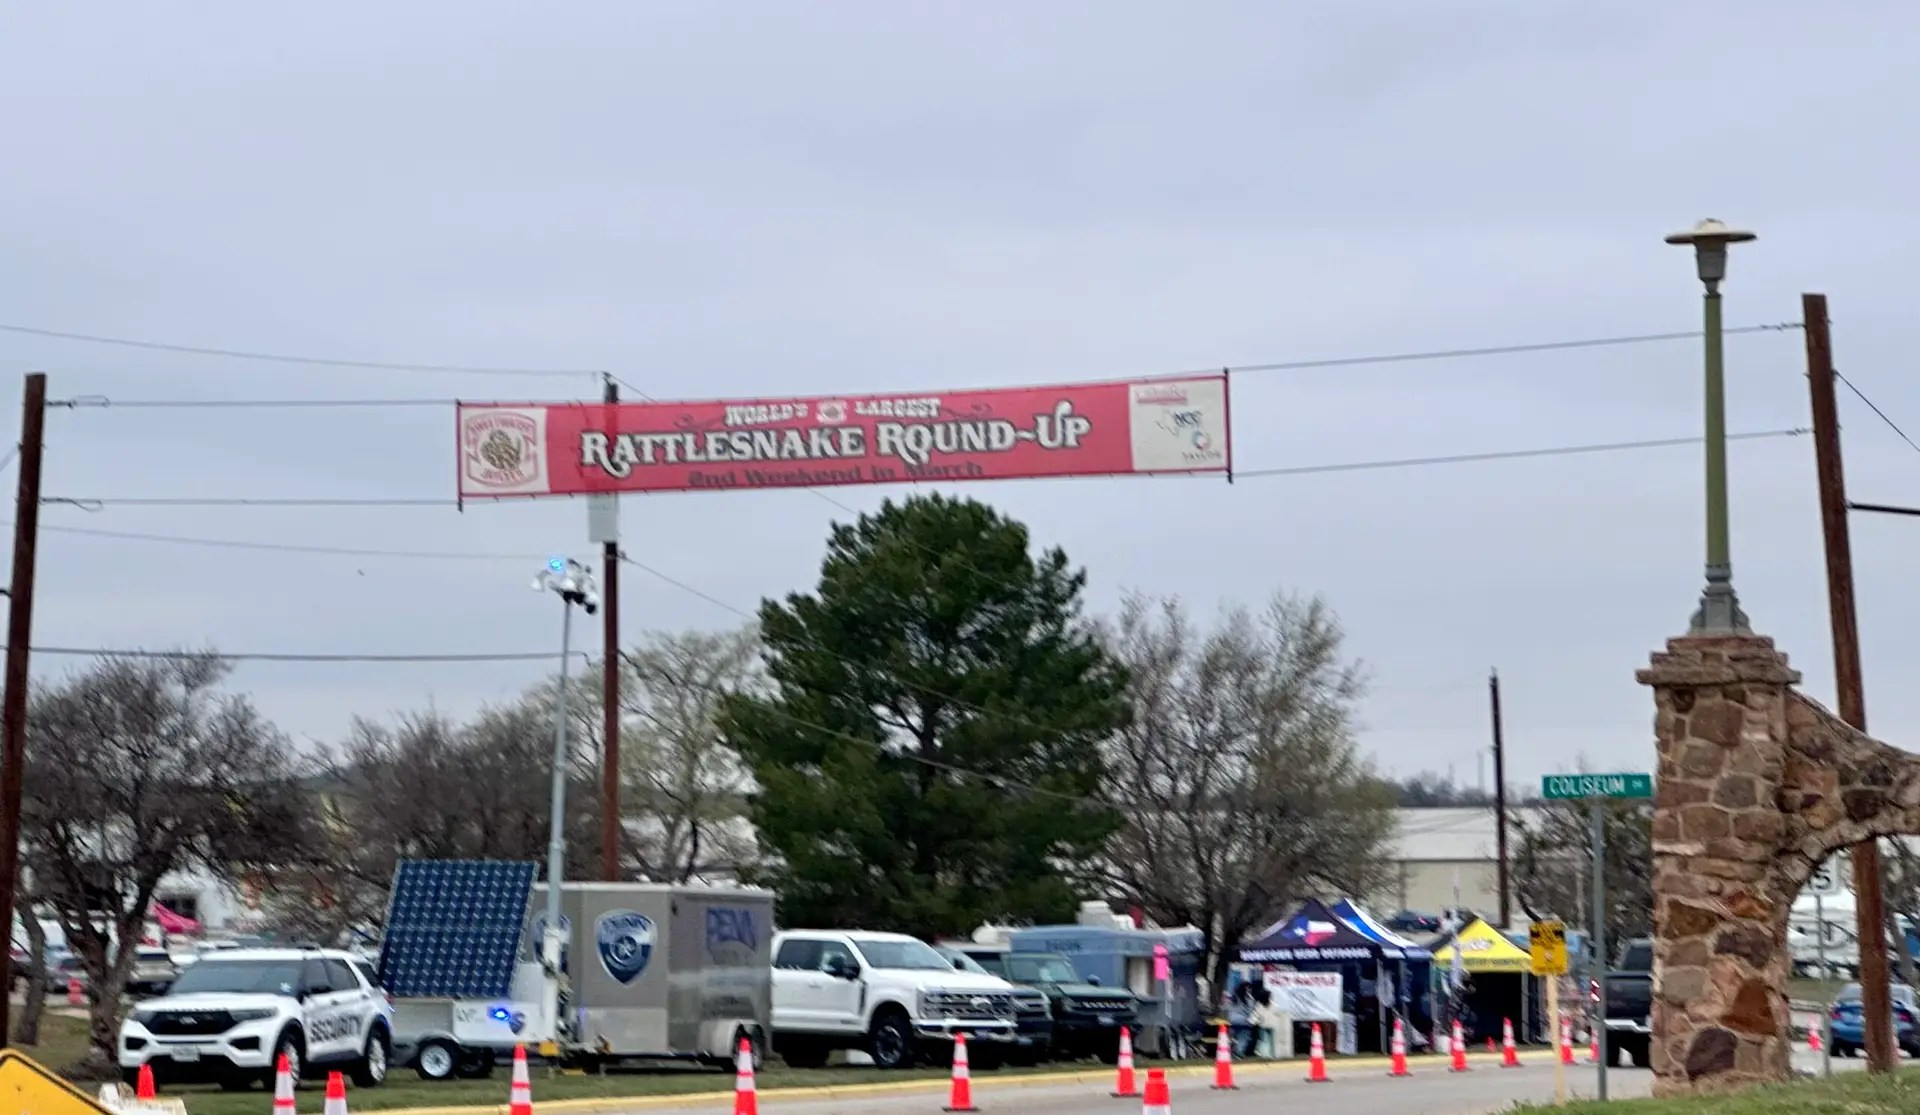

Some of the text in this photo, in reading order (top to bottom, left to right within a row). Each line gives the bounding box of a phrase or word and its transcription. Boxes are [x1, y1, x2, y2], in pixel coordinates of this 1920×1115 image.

[725, 398, 941, 426] WORLD'S LARGEST
[578, 399, 1093, 479] RATTLESNAKE ROUND-UP
[687, 469, 737, 487] 2nd
[744, 465, 862, 485] Weekend
[904, 460, 984, 480] March
[1549, 775, 1626, 796] COLISEUM
[308, 1012, 363, 1045] SECURITY
